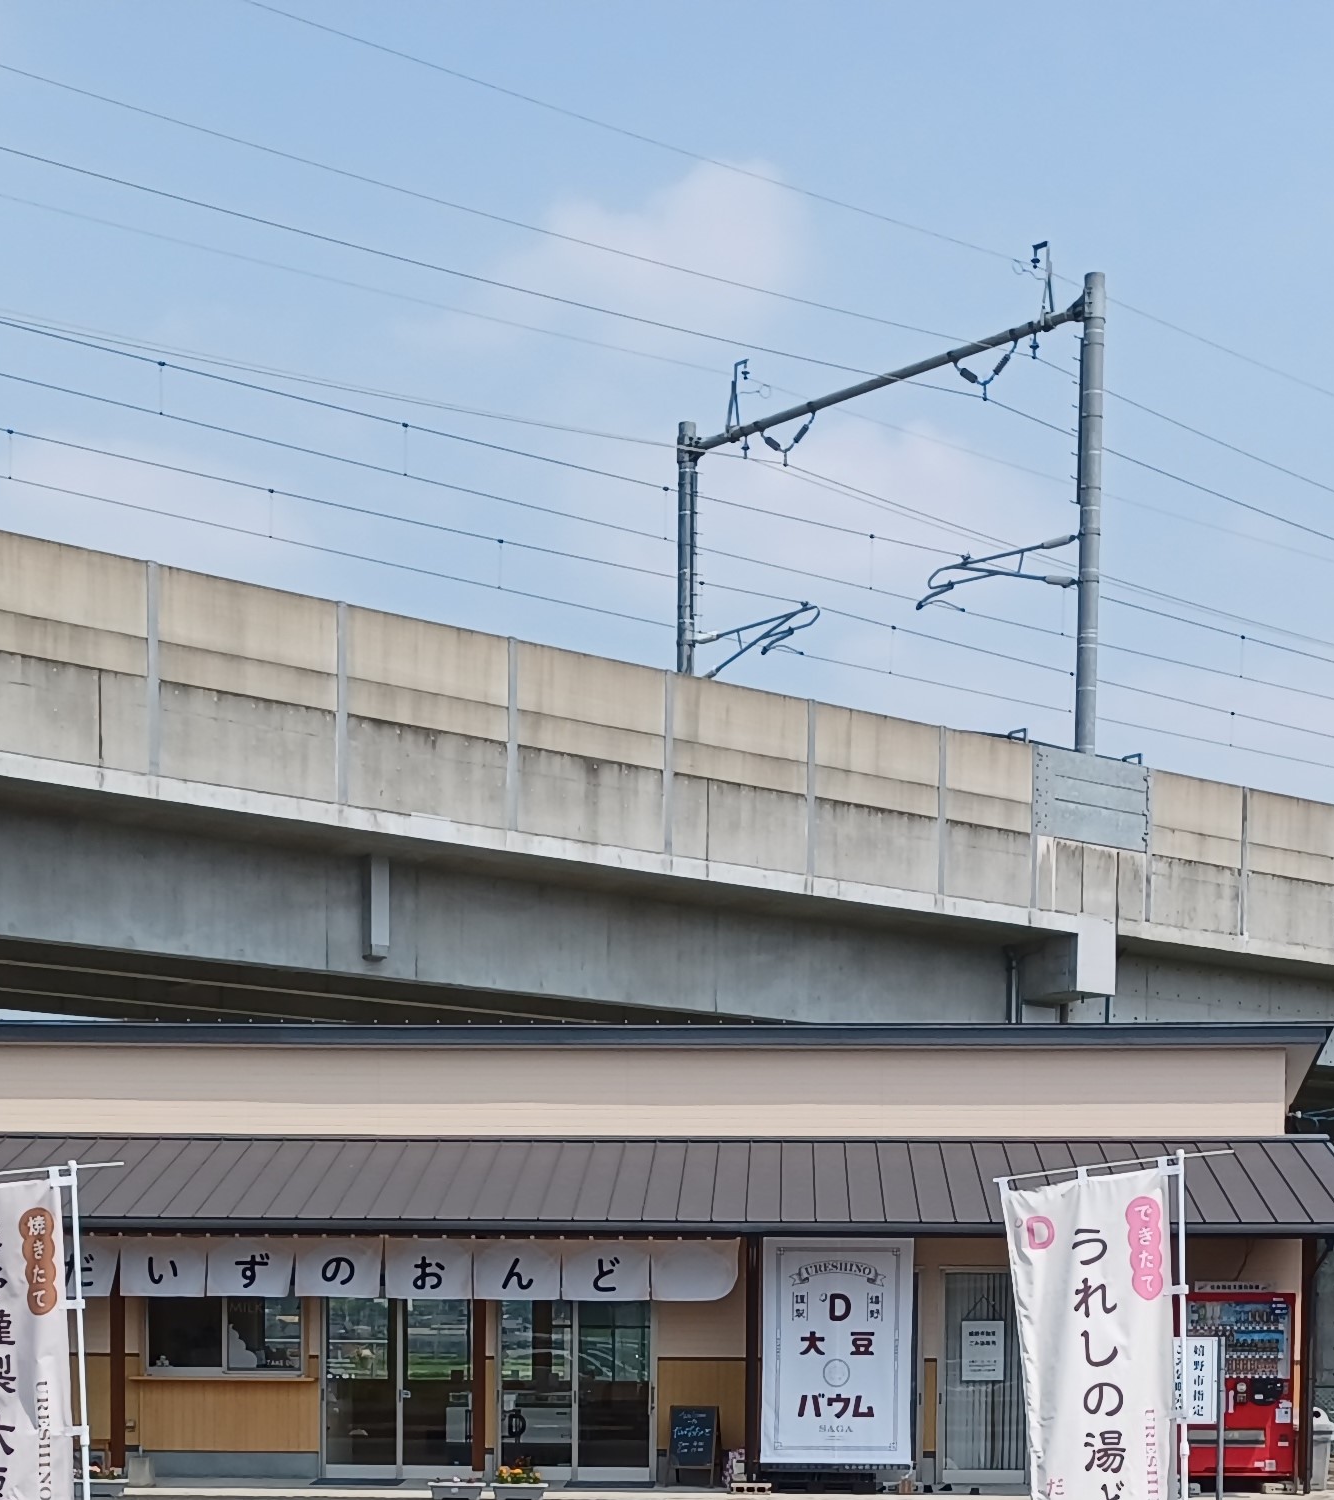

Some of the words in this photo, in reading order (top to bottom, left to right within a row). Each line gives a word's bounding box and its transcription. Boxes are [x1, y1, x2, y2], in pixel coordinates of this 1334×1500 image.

[27, 1215, 47, 1308] 焼きたて
[1133, 1204, 1154, 1292] できたて
[64, 1253, 621, 1293] だいずのおんど
[804, 1261, 872, 1276] URESHINO
[1192, 1345, 1205, 1417] 嬉野市指定
[797, 1393, 875, 1419] バウム
[818, 1424, 854, 1433] SAGA
